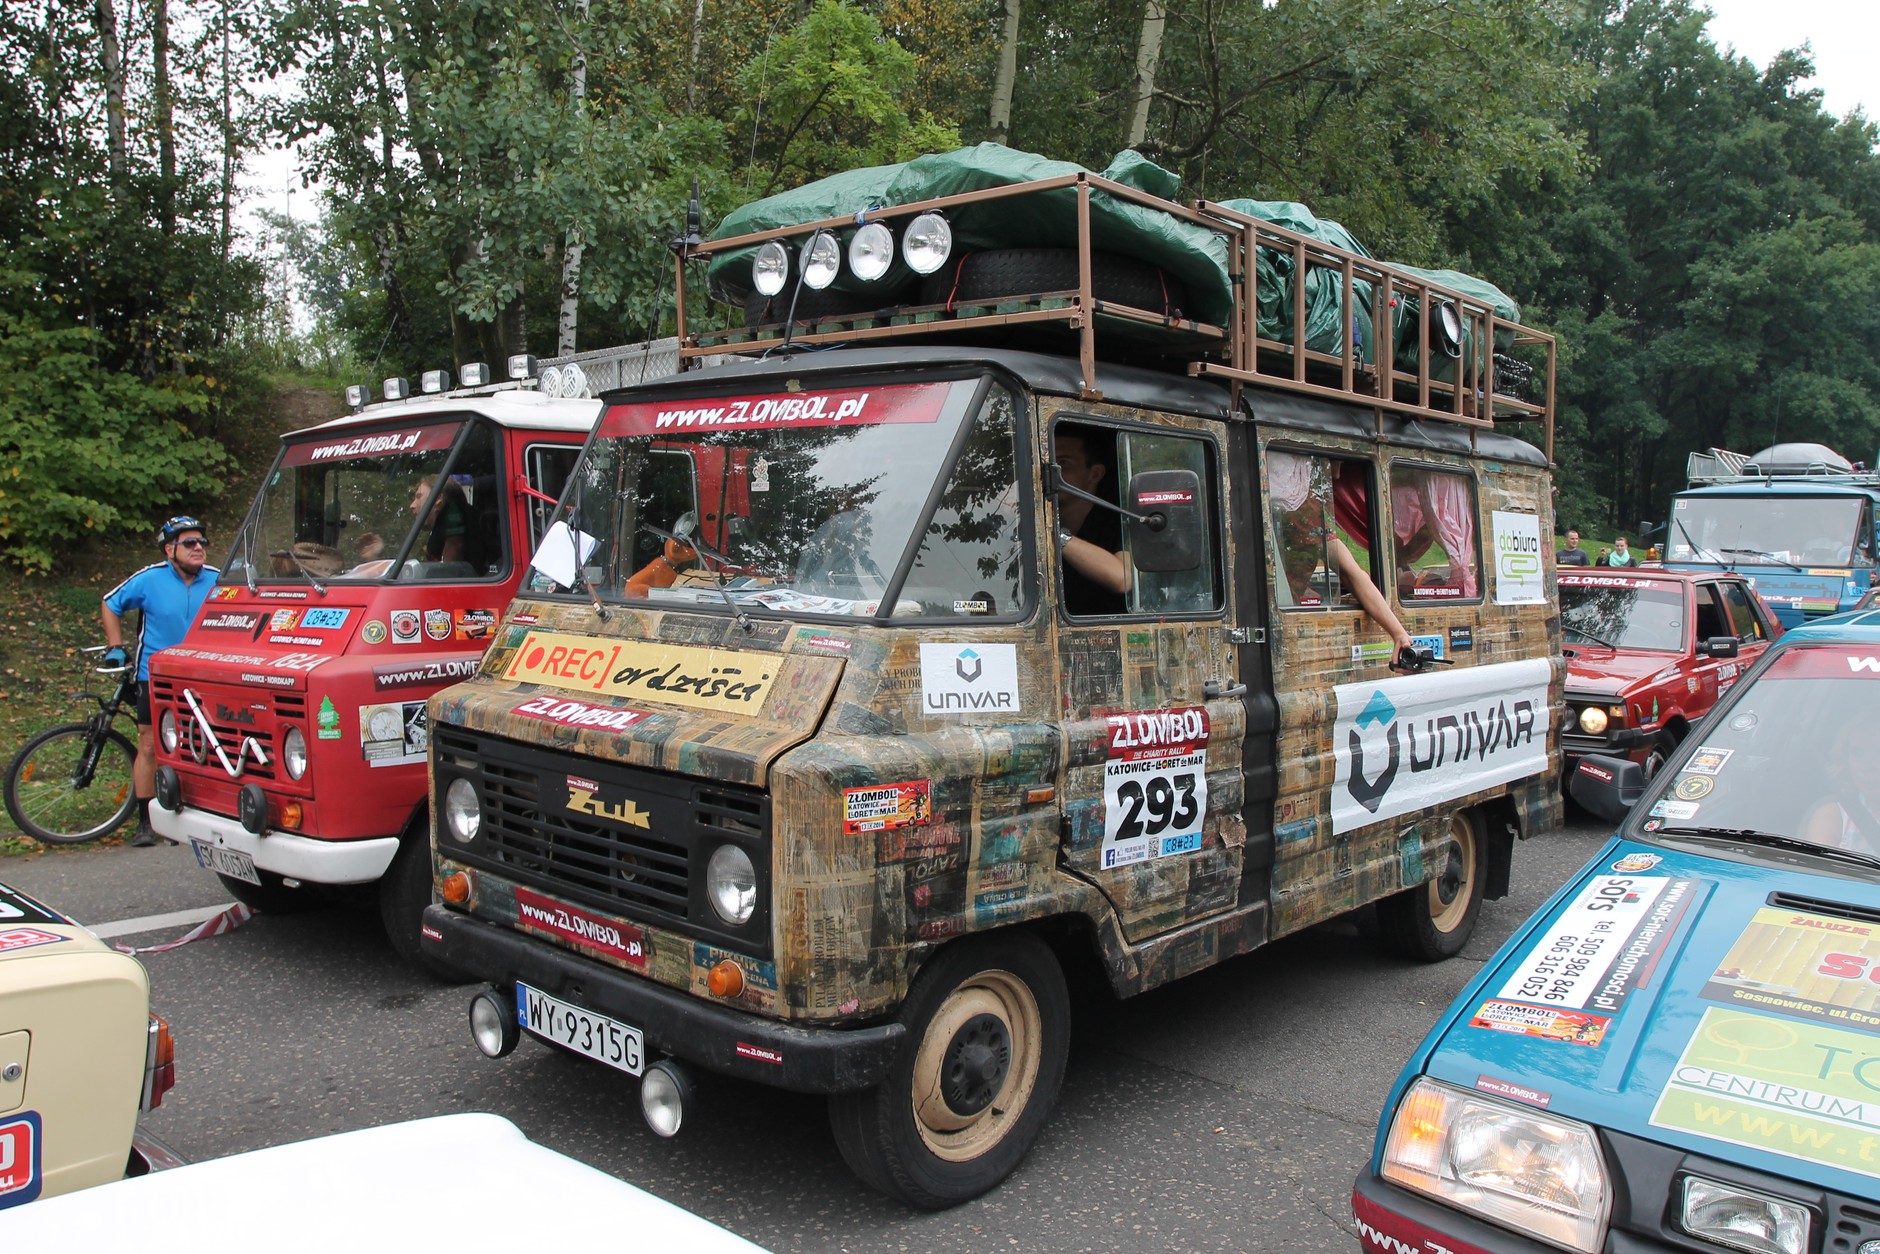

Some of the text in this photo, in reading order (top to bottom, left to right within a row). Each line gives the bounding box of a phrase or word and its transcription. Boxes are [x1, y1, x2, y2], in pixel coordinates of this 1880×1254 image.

[655, 393, 868, 428] www.ZLOMBOL.pl
[311, 430, 421, 460] www.ZLOMBOL.pl
[1499, 529, 1538, 552] dobiura
[927, 690, 1012, 710] UNIVAR
[1408, 699, 1534, 774] UNIVAR
[1187, 756, 1204, 766] MAR
[880, 806, 897, 815] MAR
[1115, 773, 1199, 841] 293
[521, 902, 643, 957] www.ZLOMBOL.pl
[1577, 937, 1605, 956] 509
[1517, 935, 1579, 997] 606 316 052
[1560, 957, 1590, 977] 984
[1544, 979, 1575, 1001] 846
[529, 993, 556, 1037] WY
[565, 1011, 639, 1069] 9315G
[1477, 1079, 1550, 1105] www.ZLOMBOL.pl
[1676, 1066, 1863, 1121] CENTRUM
